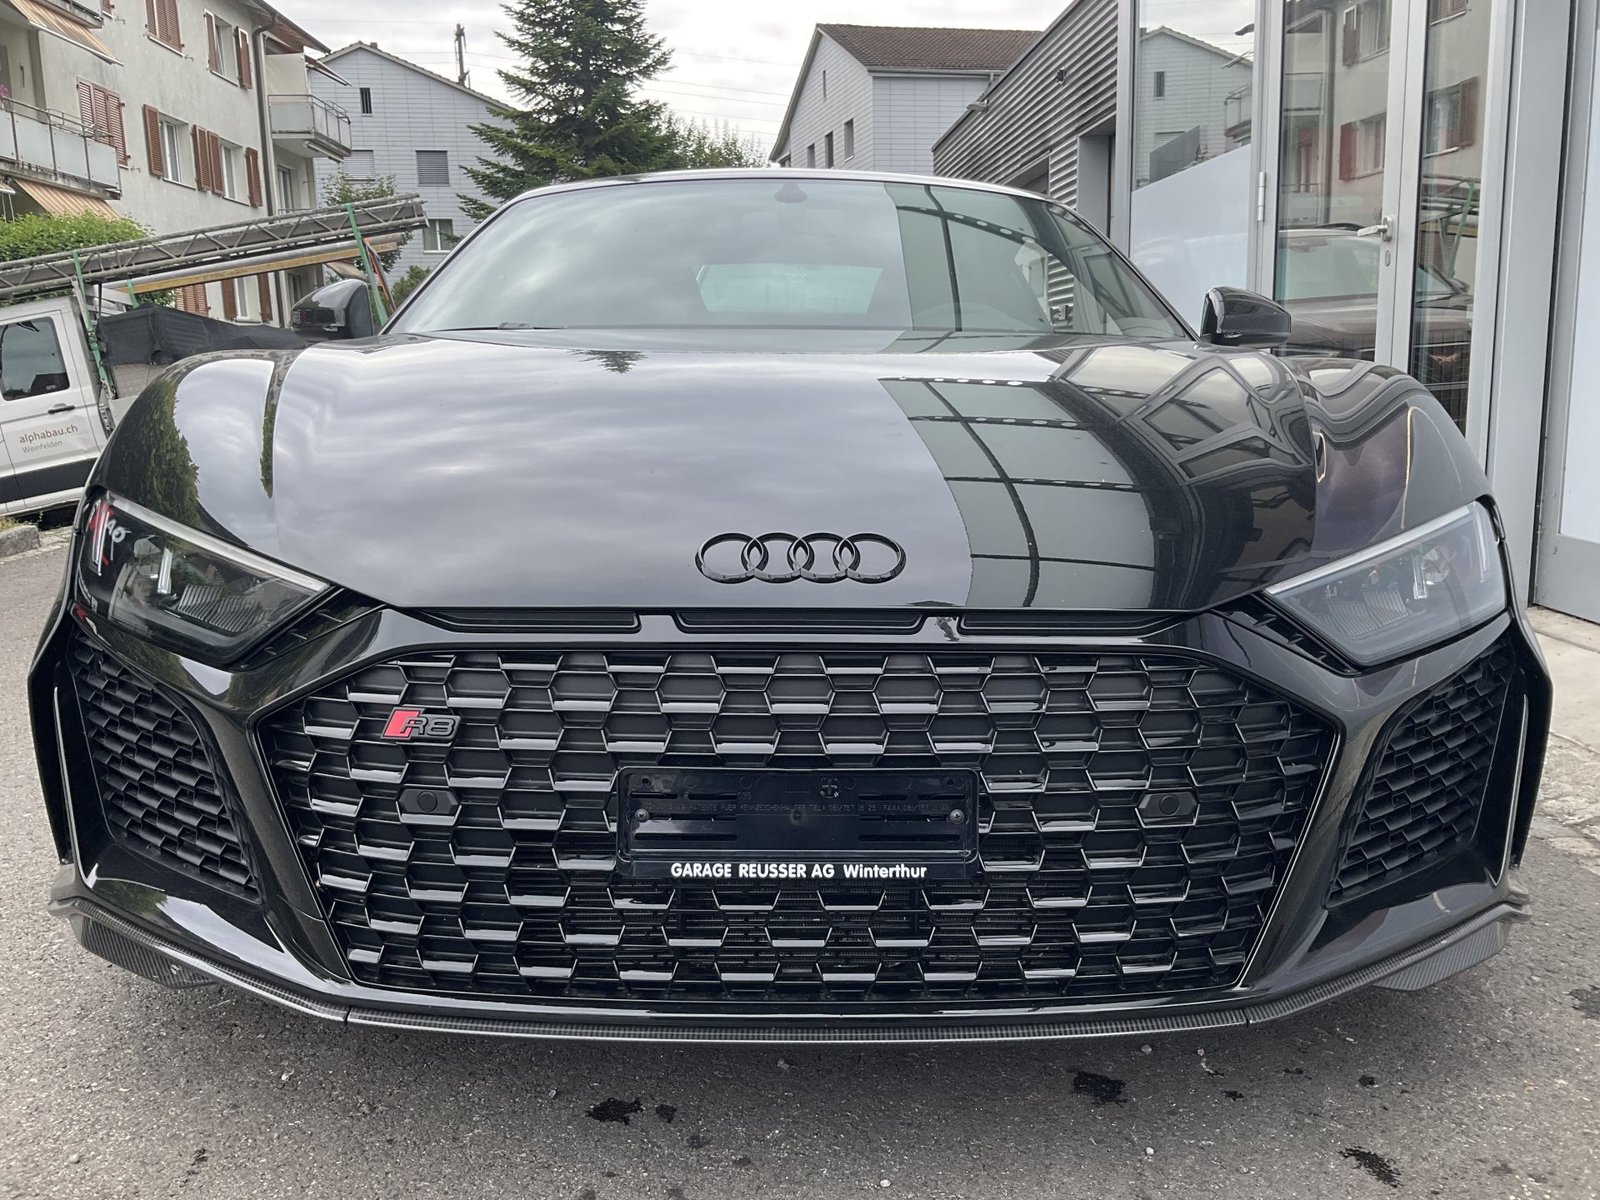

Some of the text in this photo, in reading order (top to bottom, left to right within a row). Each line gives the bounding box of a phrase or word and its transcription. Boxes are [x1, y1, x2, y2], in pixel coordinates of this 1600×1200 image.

[19, 424, 79, 443] alphabau.ch
[22, 440, 63, 454] Weinfelden
[670, 862, 928, 878] GARAGE REUSSER AG Winterthur
